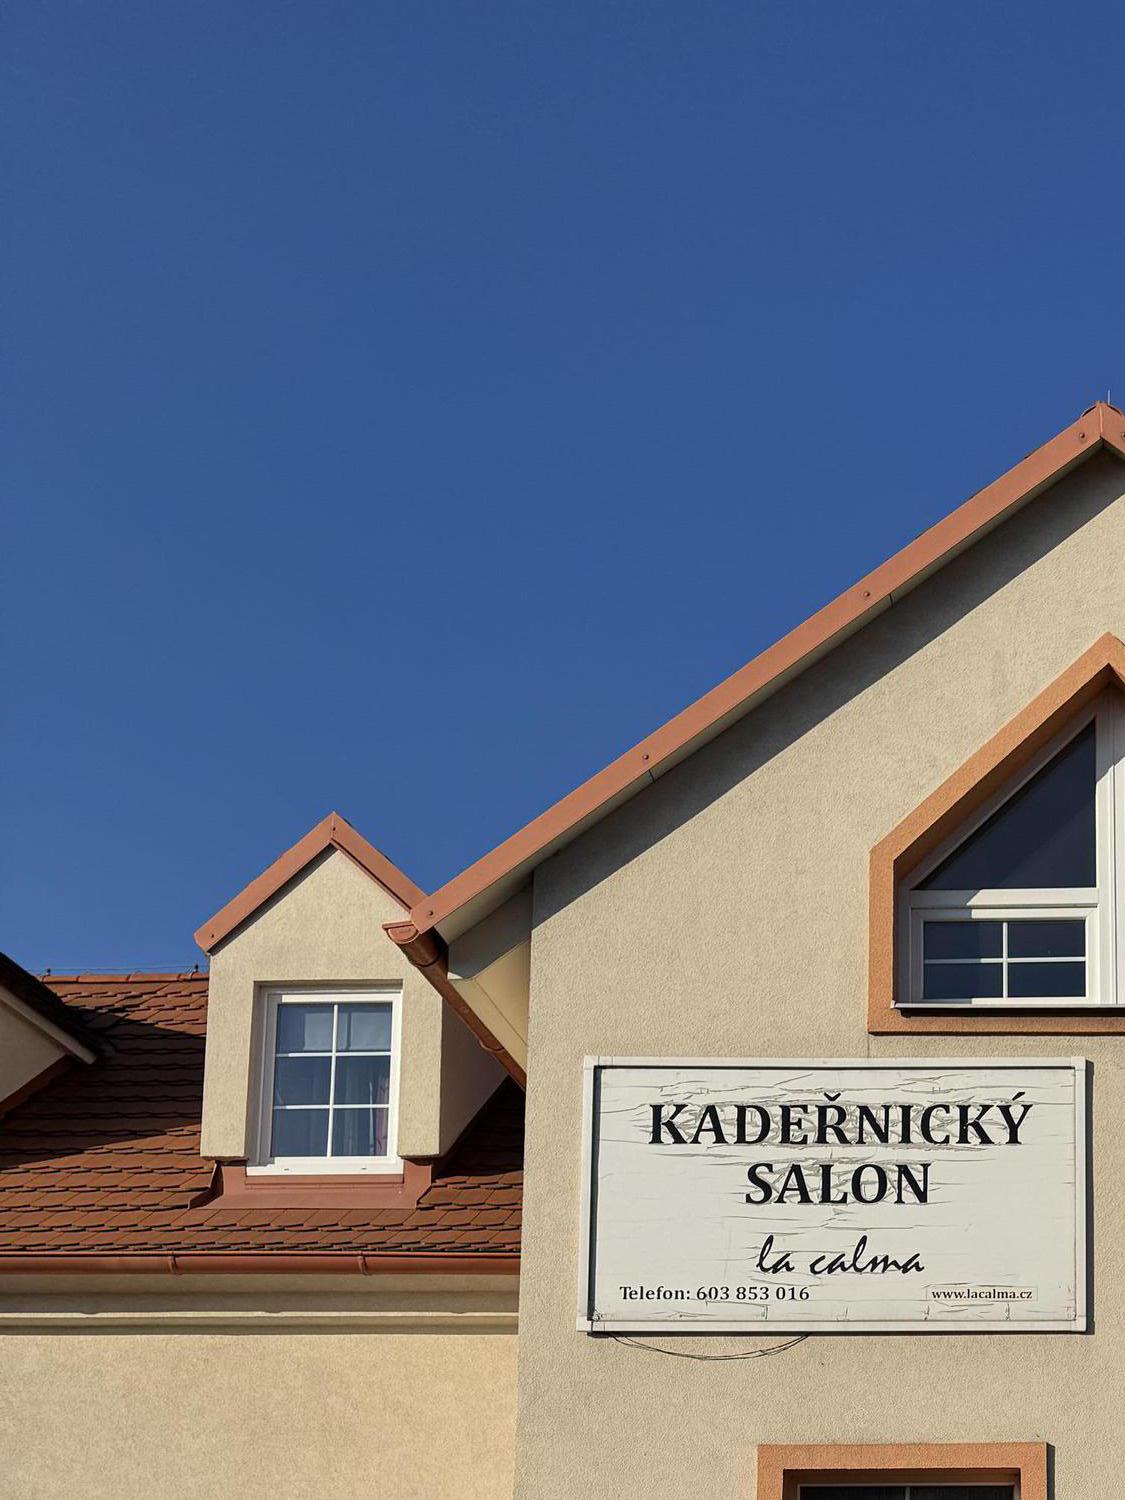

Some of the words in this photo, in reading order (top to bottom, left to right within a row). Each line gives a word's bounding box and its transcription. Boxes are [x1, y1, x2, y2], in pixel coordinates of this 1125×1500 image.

[648, 1091, 1034, 1145] KADEŘNICKÝ
[744, 1162, 932, 1205] SALON
[756, 1234, 796, 1275] la
[809, 1234, 925, 1276] calma
[619, 1285, 691, 1301] Telefon:
[696, 1286, 730, 1301] 603
[736, 1286, 770, 1301] 853
[775, 1286, 810, 1301] 016
[931, 1287, 1033, 1300] www.lacalma.cz
